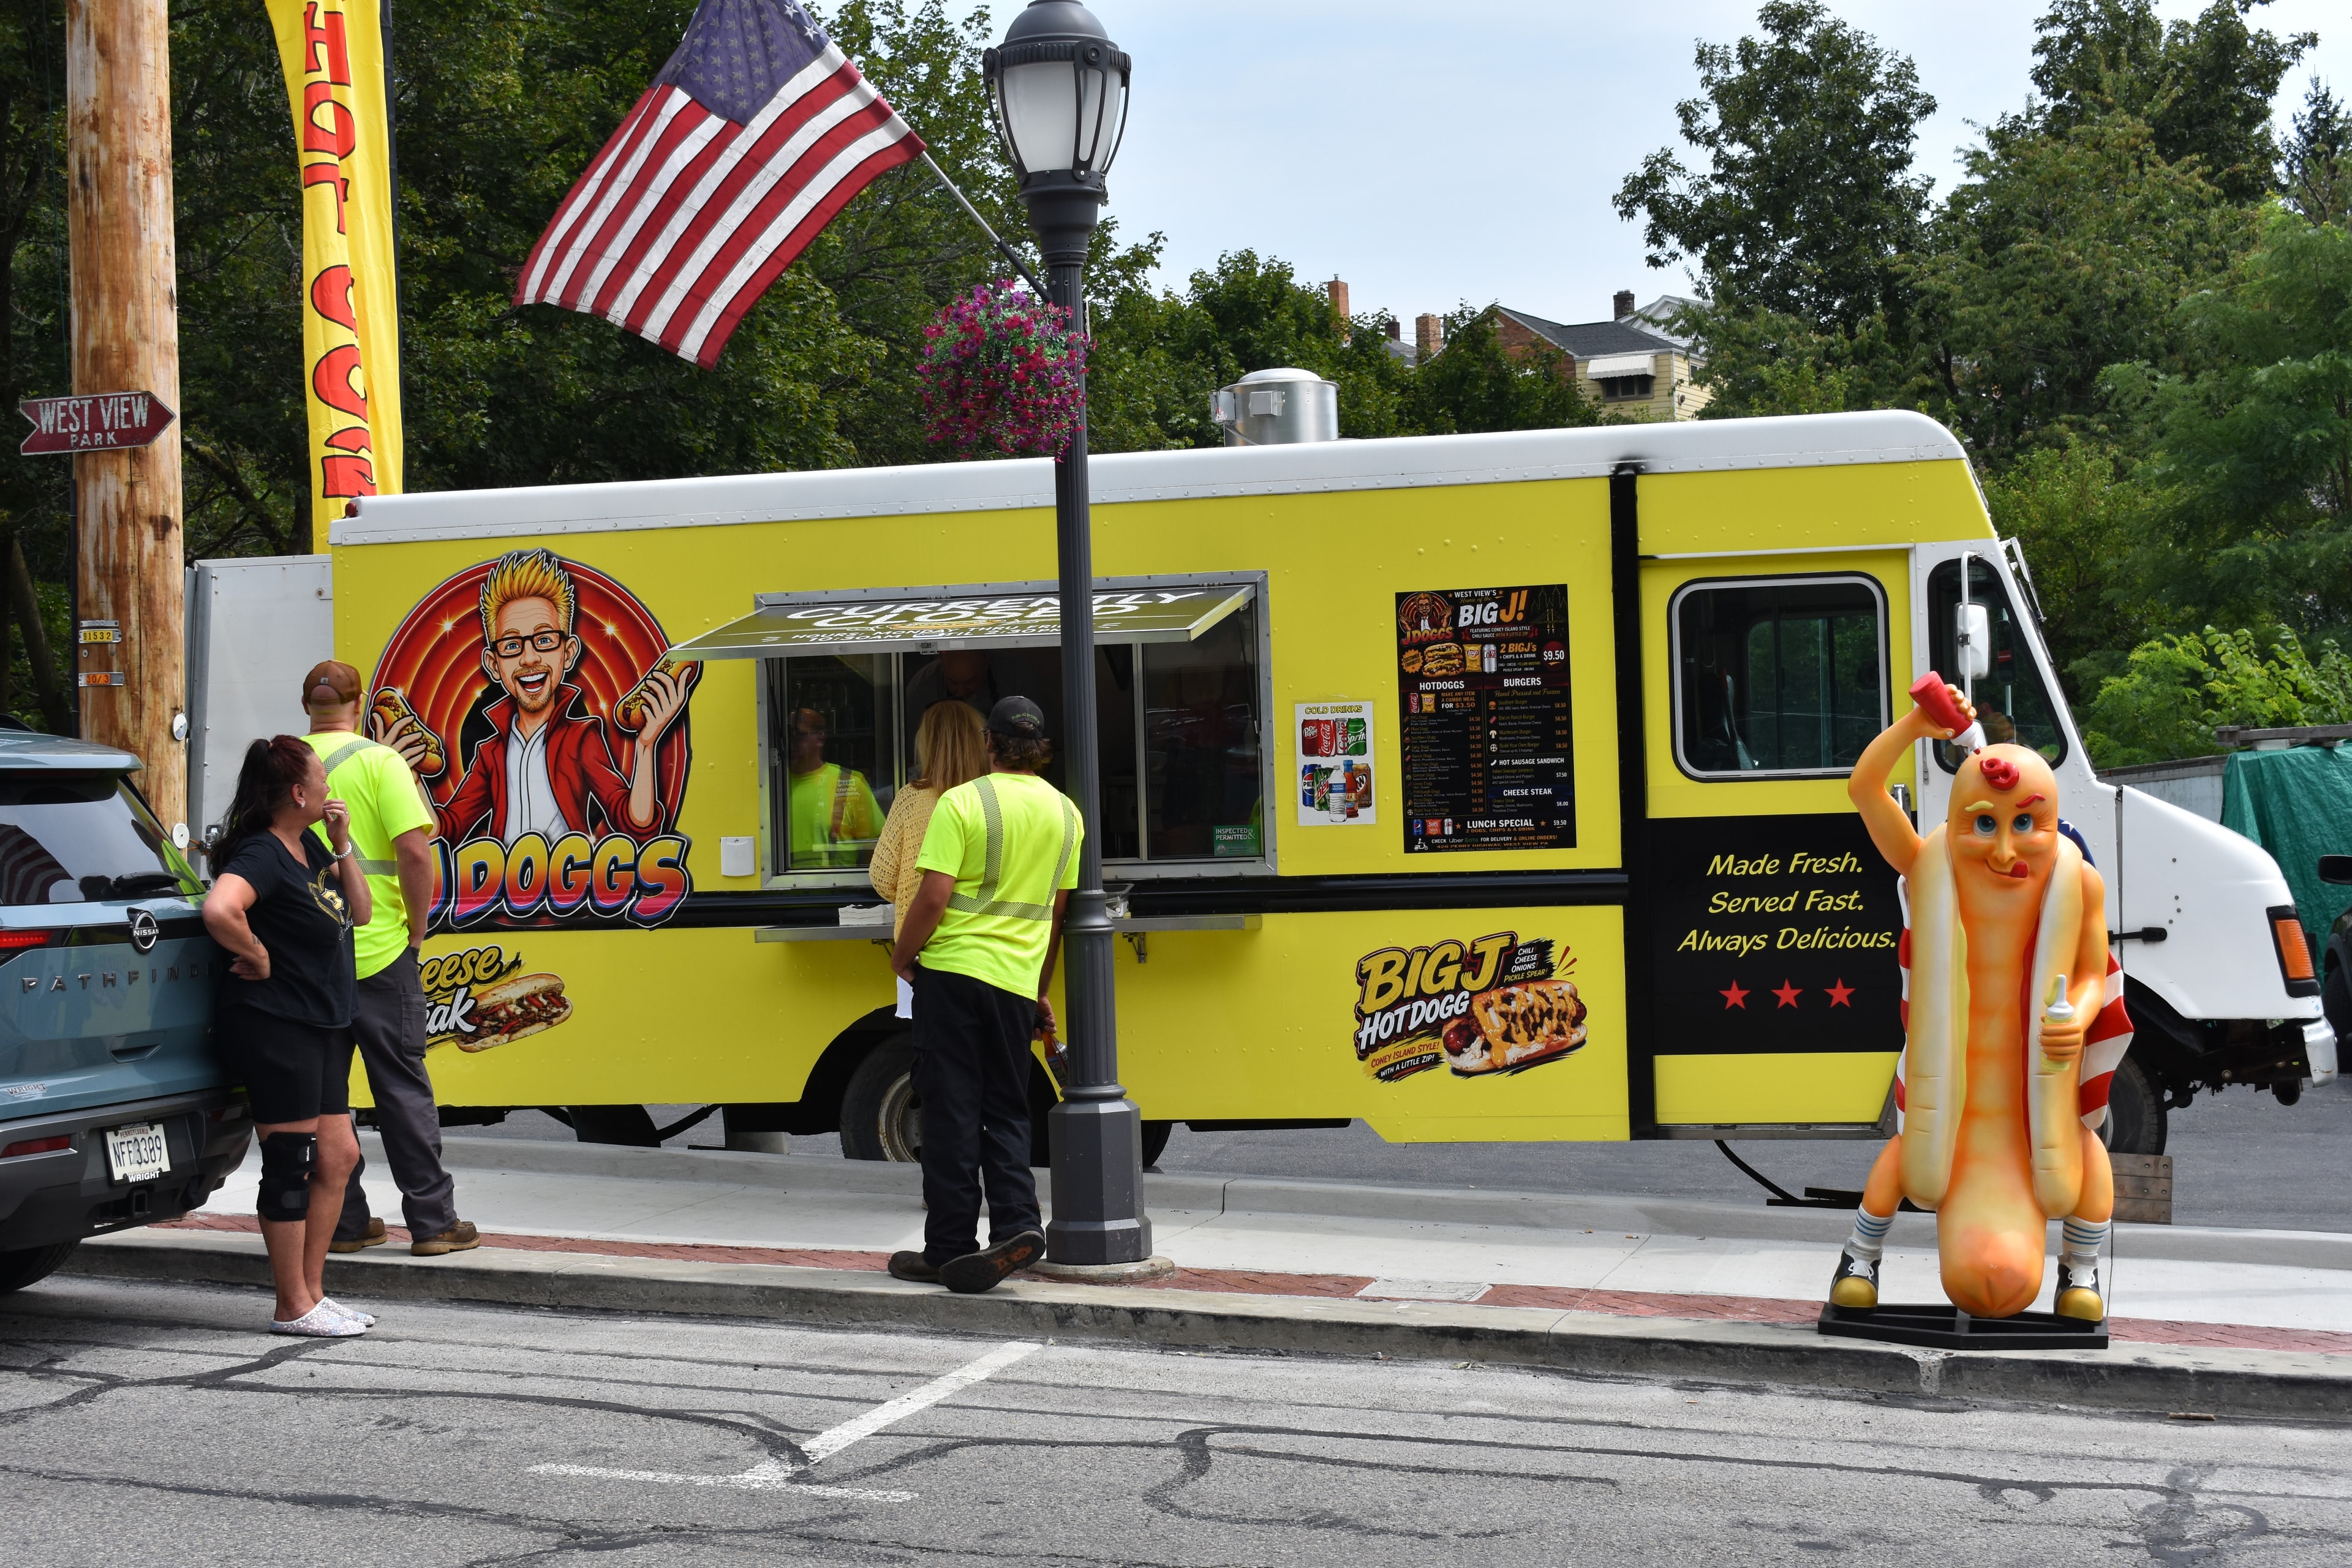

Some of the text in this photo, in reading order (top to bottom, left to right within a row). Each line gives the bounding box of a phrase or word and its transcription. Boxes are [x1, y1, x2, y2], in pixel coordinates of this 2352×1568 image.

[39, 395, 149, 434] WEST VIEW
[70, 431, 118, 448] PARK
[1458, 589, 1528, 627] BIG J!
[83, 631, 111, 641] 91532
[808, 635, 904, 643] 10:30AM
[1412, 627, 1454, 645] DOGGS
[1499, 644, 1507, 654] 2
[1543, 650, 1564, 662] $9.50
[1419, 680, 1464, 691] HOTDOGGS
[1504, 677, 1542, 687] BURGERS
[1330, 705, 1363, 714] DRINKS
[1338, 722, 1348, 751] Coke
[1503, 787, 1553, 797] CHEESE STEAK
[1467, 818, 1534, 829] LUNCH SPECIAL
[1247, 828, 1256, 840] &
[1706, 852, 1863, 876] Made Fresh.
[454, 832, 687, 921] DOGGS
[1708, 889, 1864, 914] Served Fast.
[132, 925, 159, 936] NISSAN
[1677, 926, 1896, 958] Always Delicious.
[22, 960, 225, 993] PATHFINDE
[1359, 935, 1511, 1014] BIG J
[1504, 968, 1548, 983] PICKLE SPEAR!
[1358, 990, 1469, 1050] HOTDOGG
[1371, 1041, 1439, 1068] CONEY ISLAND STYLE!
[1380, 1066, 1395, 1077] WITH
[1401, 1057, 1420, 1069] LITTLE
[1421, 1054, 1435, 1063] ZIP!
[6, 1083, 47, 1095] WRIGHT
[119, 1128, 149, 1139] PENNSYLVANIA
[127, 1170, 160, 1183] WRIGHT
